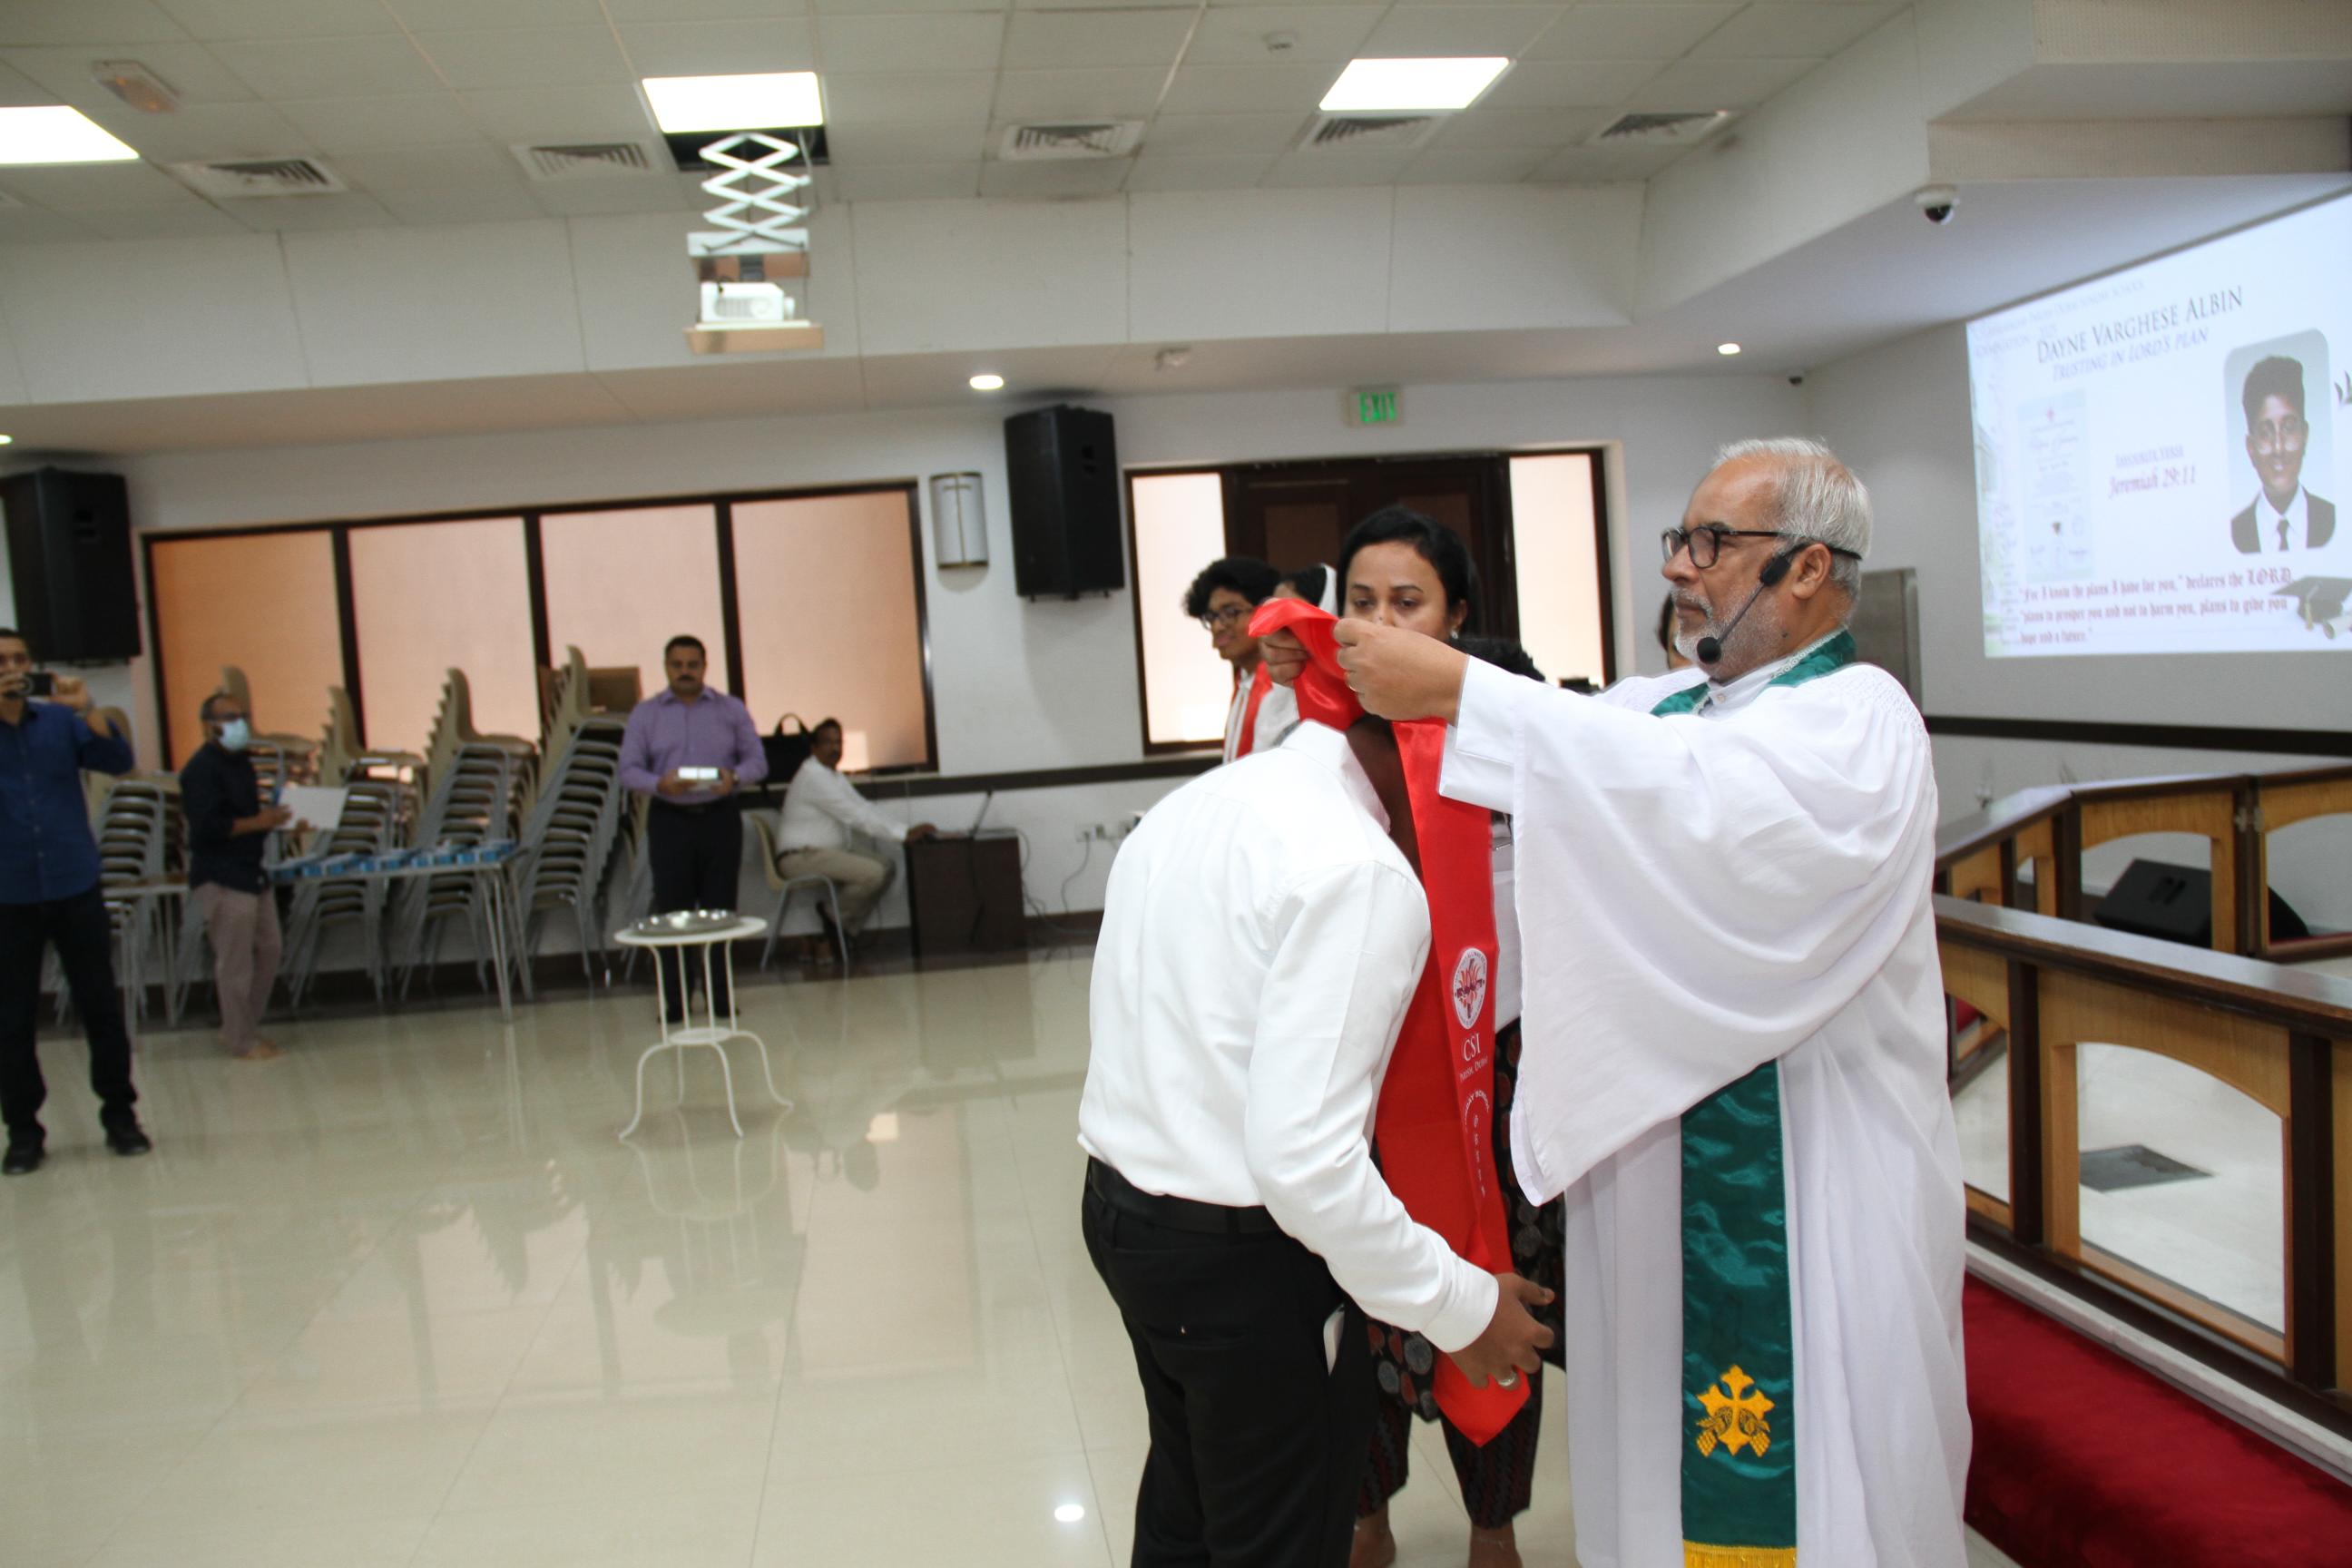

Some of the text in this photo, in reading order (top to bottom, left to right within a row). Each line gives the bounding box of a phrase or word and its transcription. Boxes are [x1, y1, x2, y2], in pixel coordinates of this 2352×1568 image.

[2037, 331, 2087, 364] DAYNE
[2092, 303, 2179, 347] VARGHESE
[2185, 285, 2243, 323] ALBIN
[2110, 348, 2124, 367] IN
[2174, 327, 2210, 350] PLAN
[1359, 391, 1396, 423] EXIT
[2108, 465, 2159, 499] Jeremiah
[2162, 464, 2196, 488] 29:11
[2186, 571, 2225, 591] declares
[2228, 570, 2243, 588] the
[2200, 598, 2227, 616] plans
[2230, 597, 2239, 613] to
[2268, 596, 2288, 613] you
[1463, 1032, 1482, 1062] CSI
